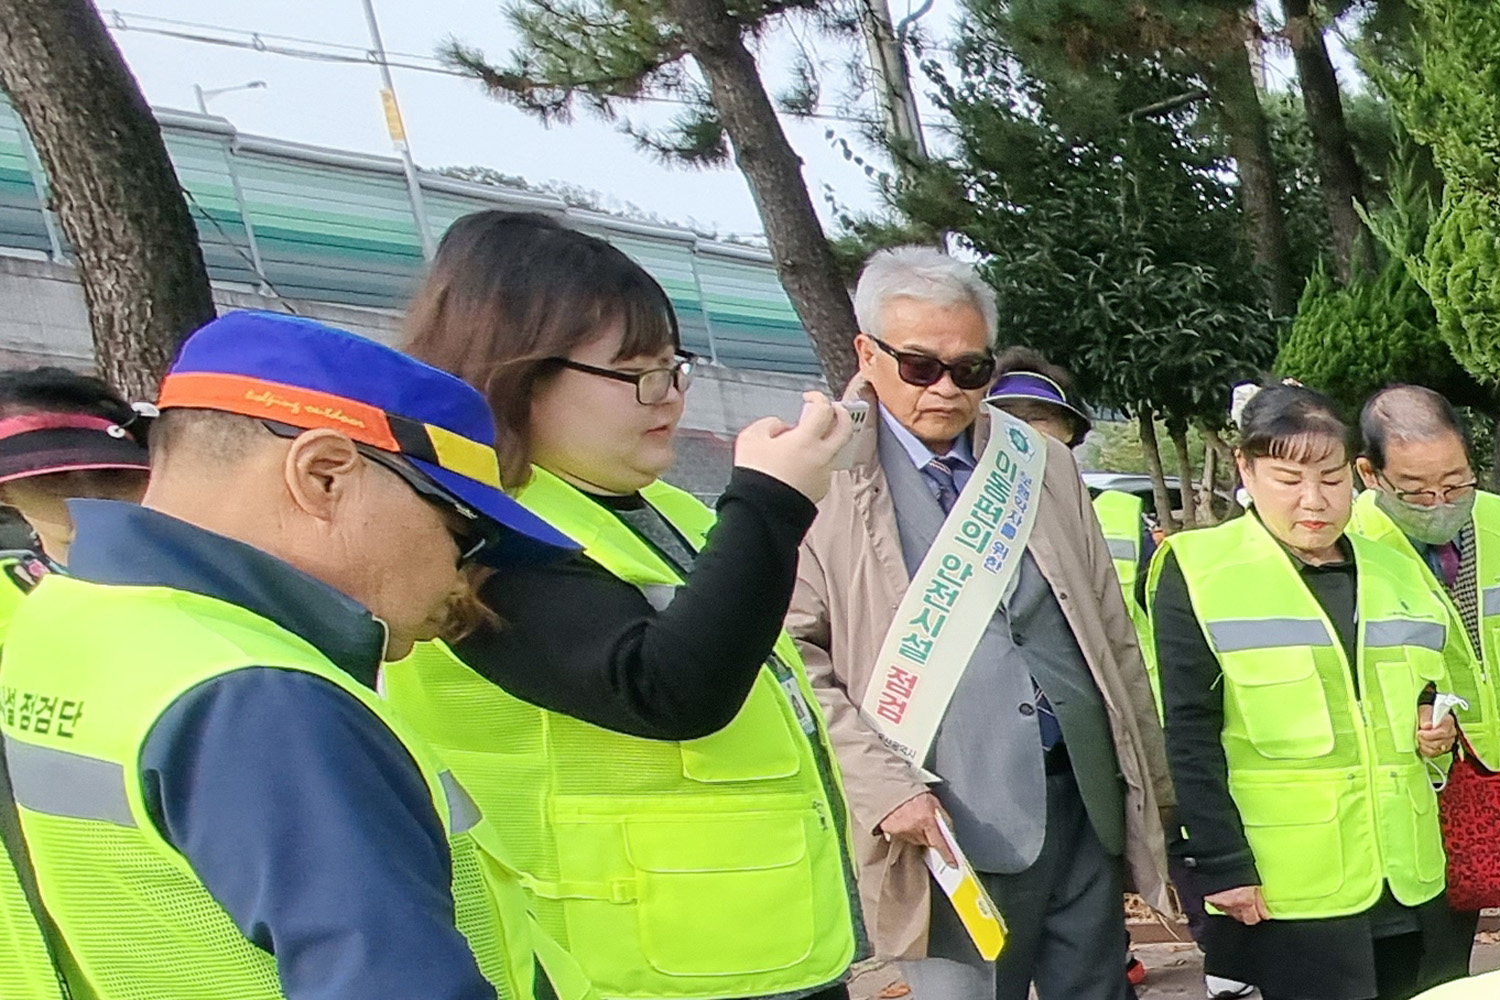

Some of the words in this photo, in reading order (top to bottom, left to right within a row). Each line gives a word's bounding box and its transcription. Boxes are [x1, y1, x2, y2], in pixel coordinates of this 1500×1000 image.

[954, 450, 1017, 554] 이동편의
[898, 554, 974, 665] 안전시설
[19, 693, 84, 739] 점검단
[876, 665, 918, 725] 점검
